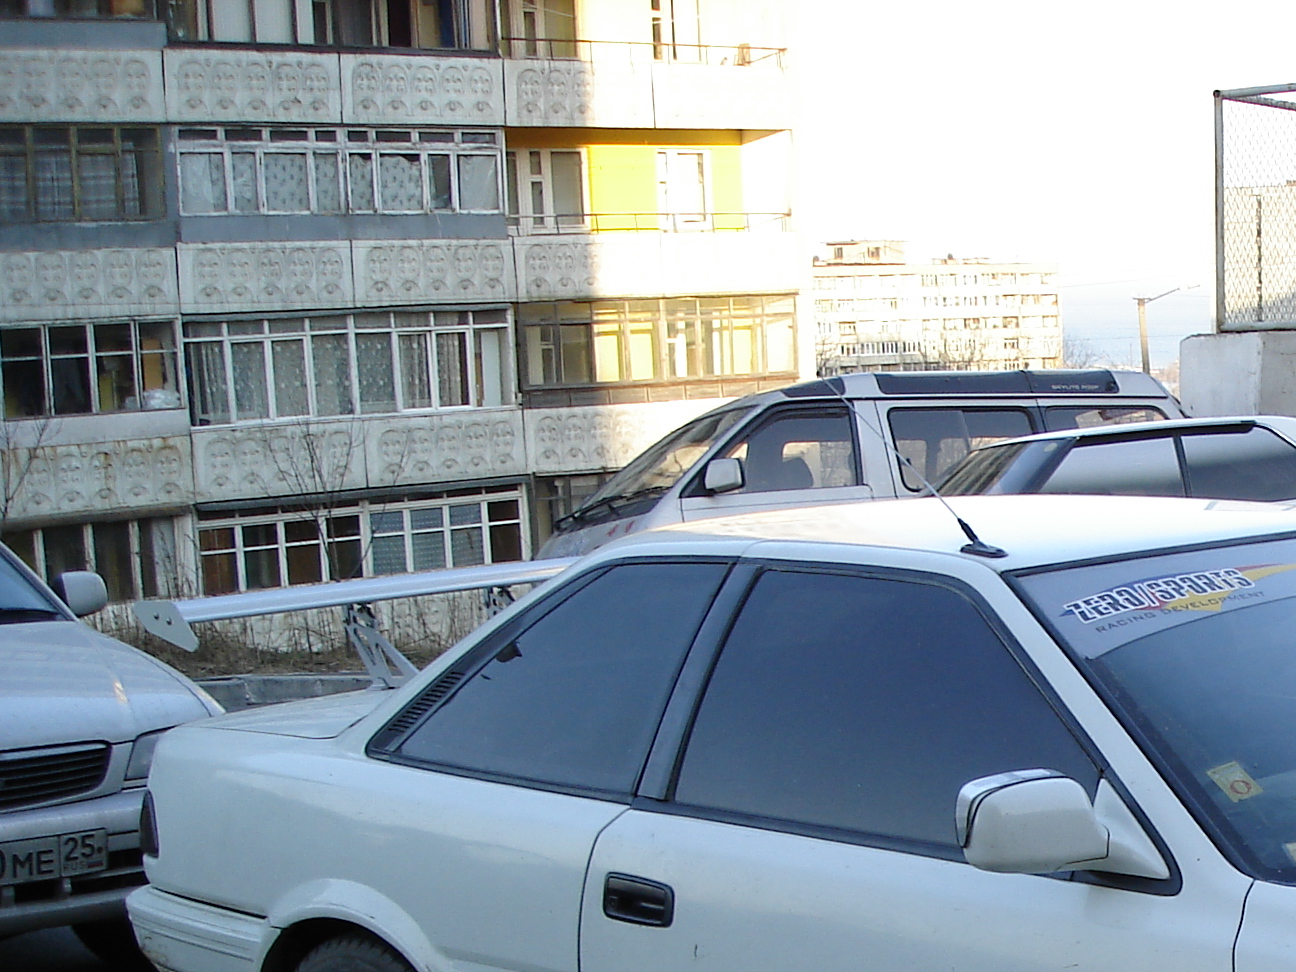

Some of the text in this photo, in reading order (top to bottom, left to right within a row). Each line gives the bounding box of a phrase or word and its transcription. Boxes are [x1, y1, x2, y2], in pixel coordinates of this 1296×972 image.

[1095, 591, 1266, 633] RACING DEVELOPMENT
[0, 833, 96, 879] ME 25
